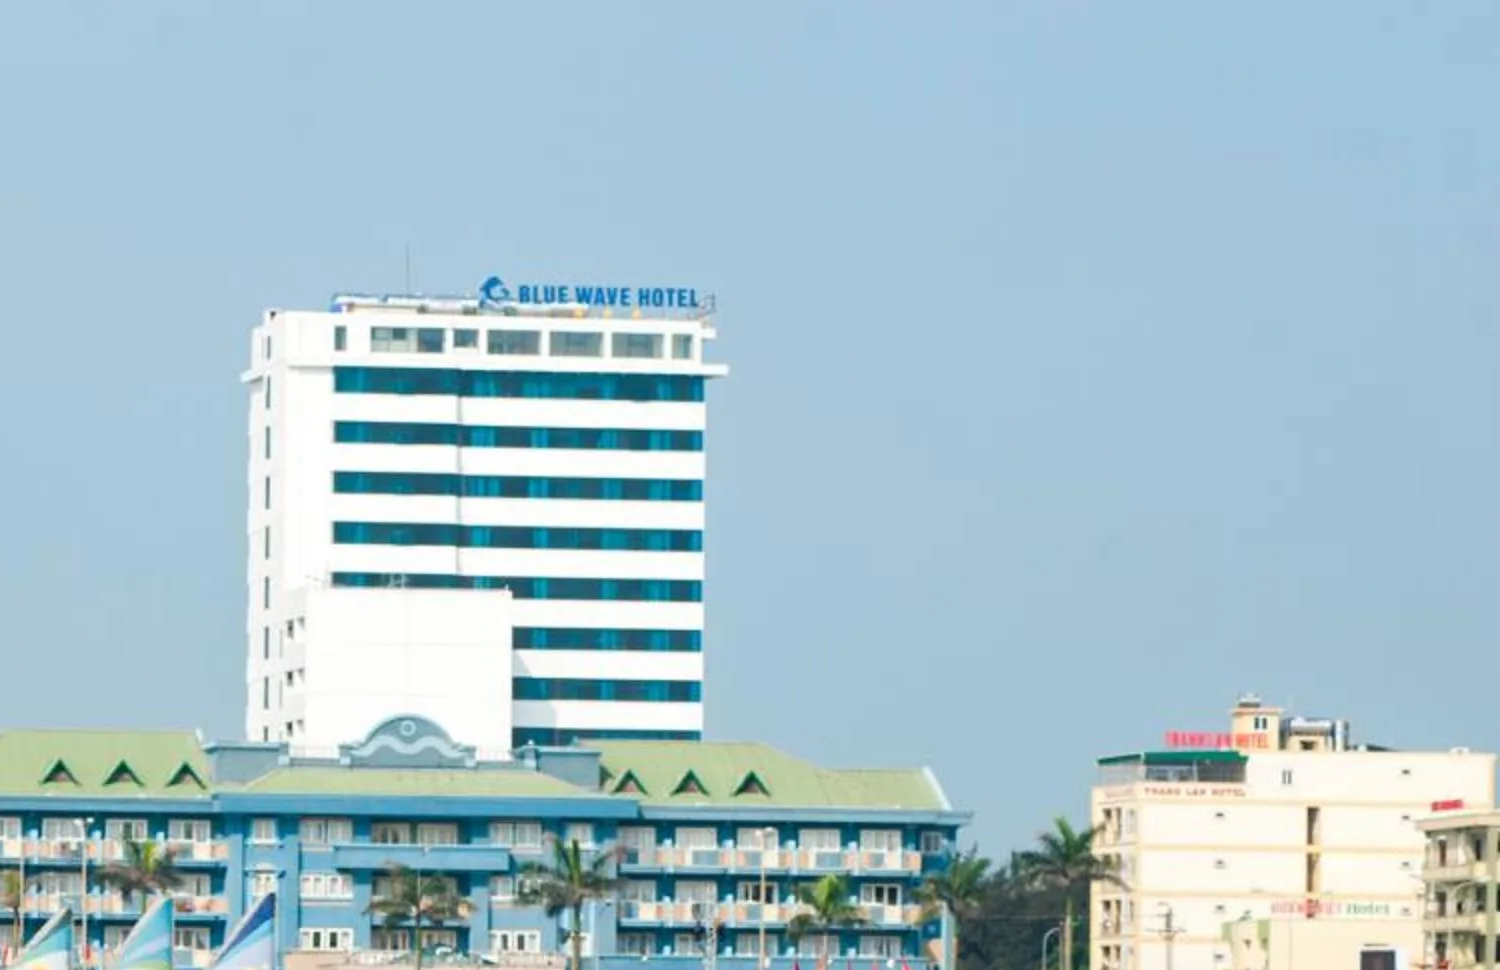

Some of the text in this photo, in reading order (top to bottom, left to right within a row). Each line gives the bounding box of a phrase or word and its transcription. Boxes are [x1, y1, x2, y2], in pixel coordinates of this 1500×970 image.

[518, 285, 699, 308] BLUE WAVE HOTEL
[1235, 732, 1268, 749] HOTEL
[1211, 786, 1246, 797] HOTEL
